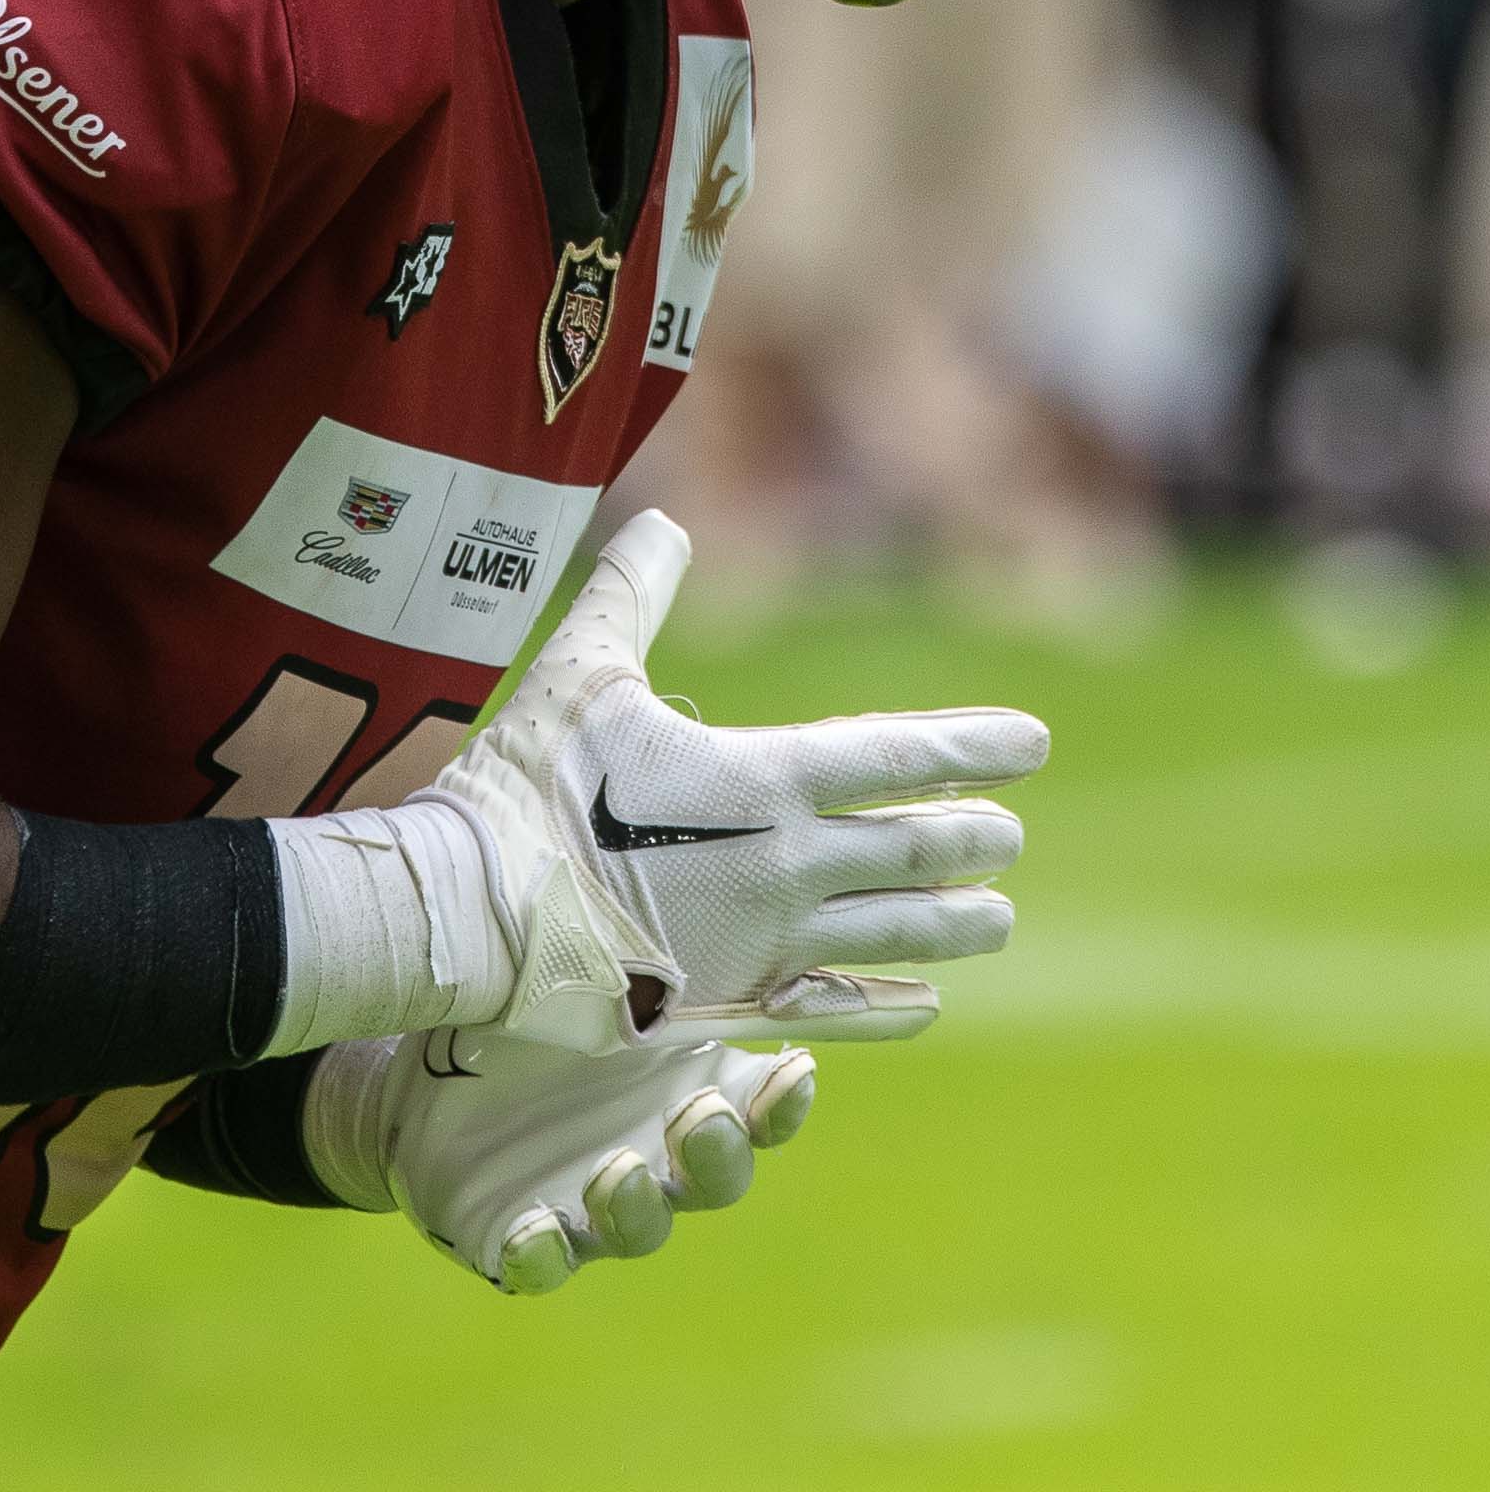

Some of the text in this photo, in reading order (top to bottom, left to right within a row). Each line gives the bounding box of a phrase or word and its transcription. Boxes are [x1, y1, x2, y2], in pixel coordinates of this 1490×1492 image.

[471, 518, 537, 547] AUTOHAUS
[295, 530, 381, 584] Cadillac
[442, 540, 536, 593] ULMEN
[450, 590, 499, 615] Düsseldorf
